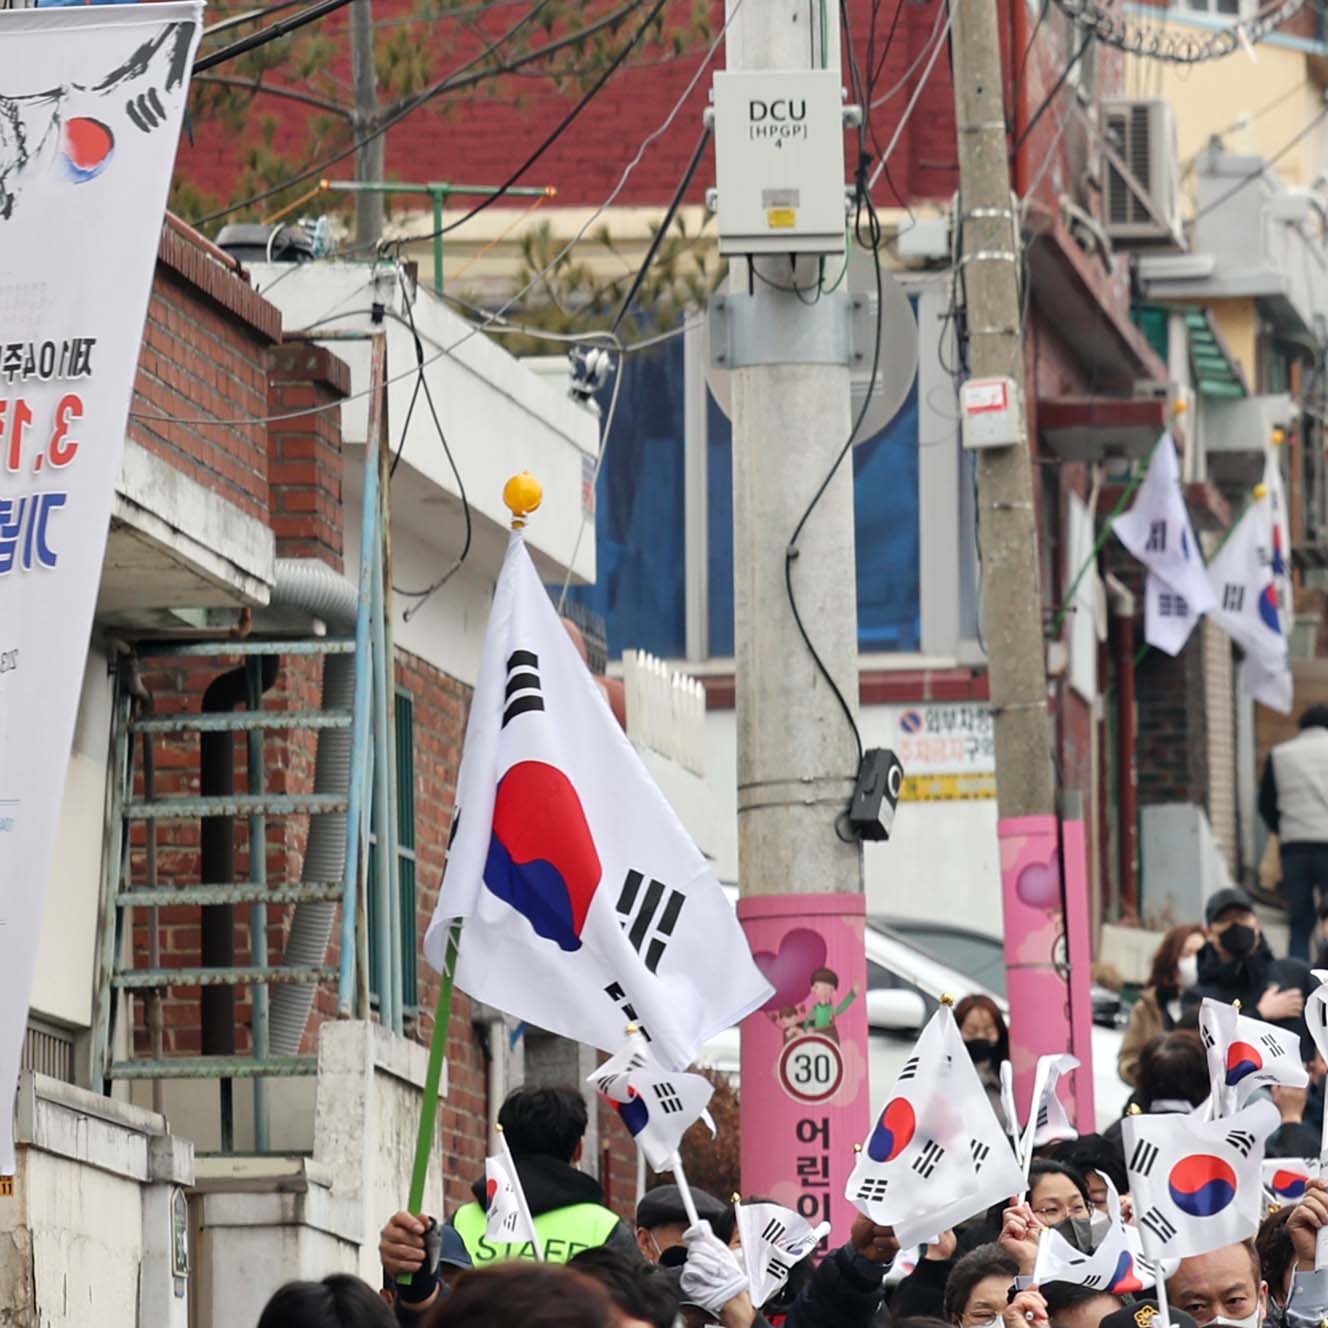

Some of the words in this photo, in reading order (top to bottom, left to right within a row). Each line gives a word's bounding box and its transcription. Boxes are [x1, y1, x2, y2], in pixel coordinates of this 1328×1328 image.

[750, 100, 806, 121] DCU
[750, 124, 808, 139] [HPGP]
[774, 138, 783, 149] 4
[794, 1053, 831, 1085] 30
